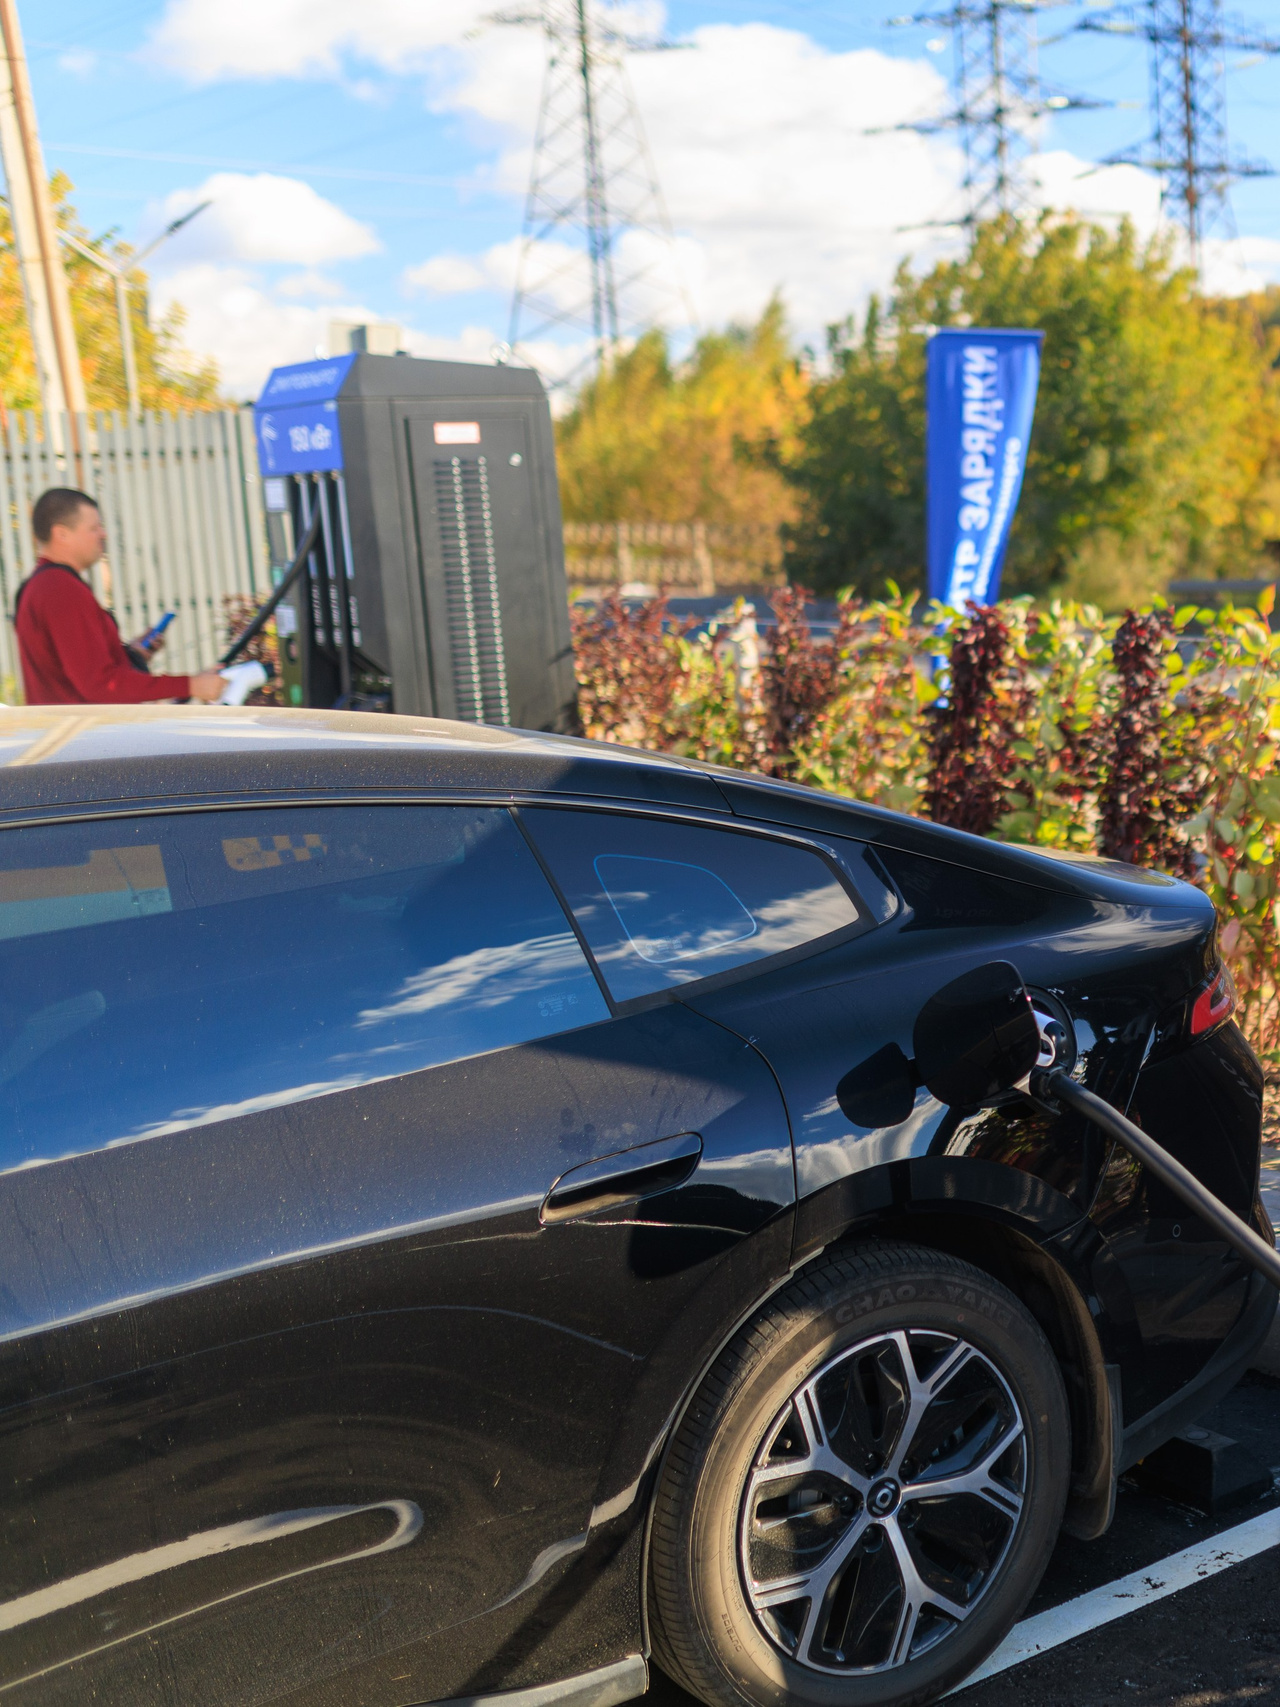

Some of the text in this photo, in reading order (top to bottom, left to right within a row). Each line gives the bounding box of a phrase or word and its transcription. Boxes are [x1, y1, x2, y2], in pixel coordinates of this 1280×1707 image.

[958, 344, 1005, 532] ЗАРЯДКИ
[835, 1284, 1012, 1329] CHAO YANG
[721, 1612, 743, 1653] OUTSIDE
